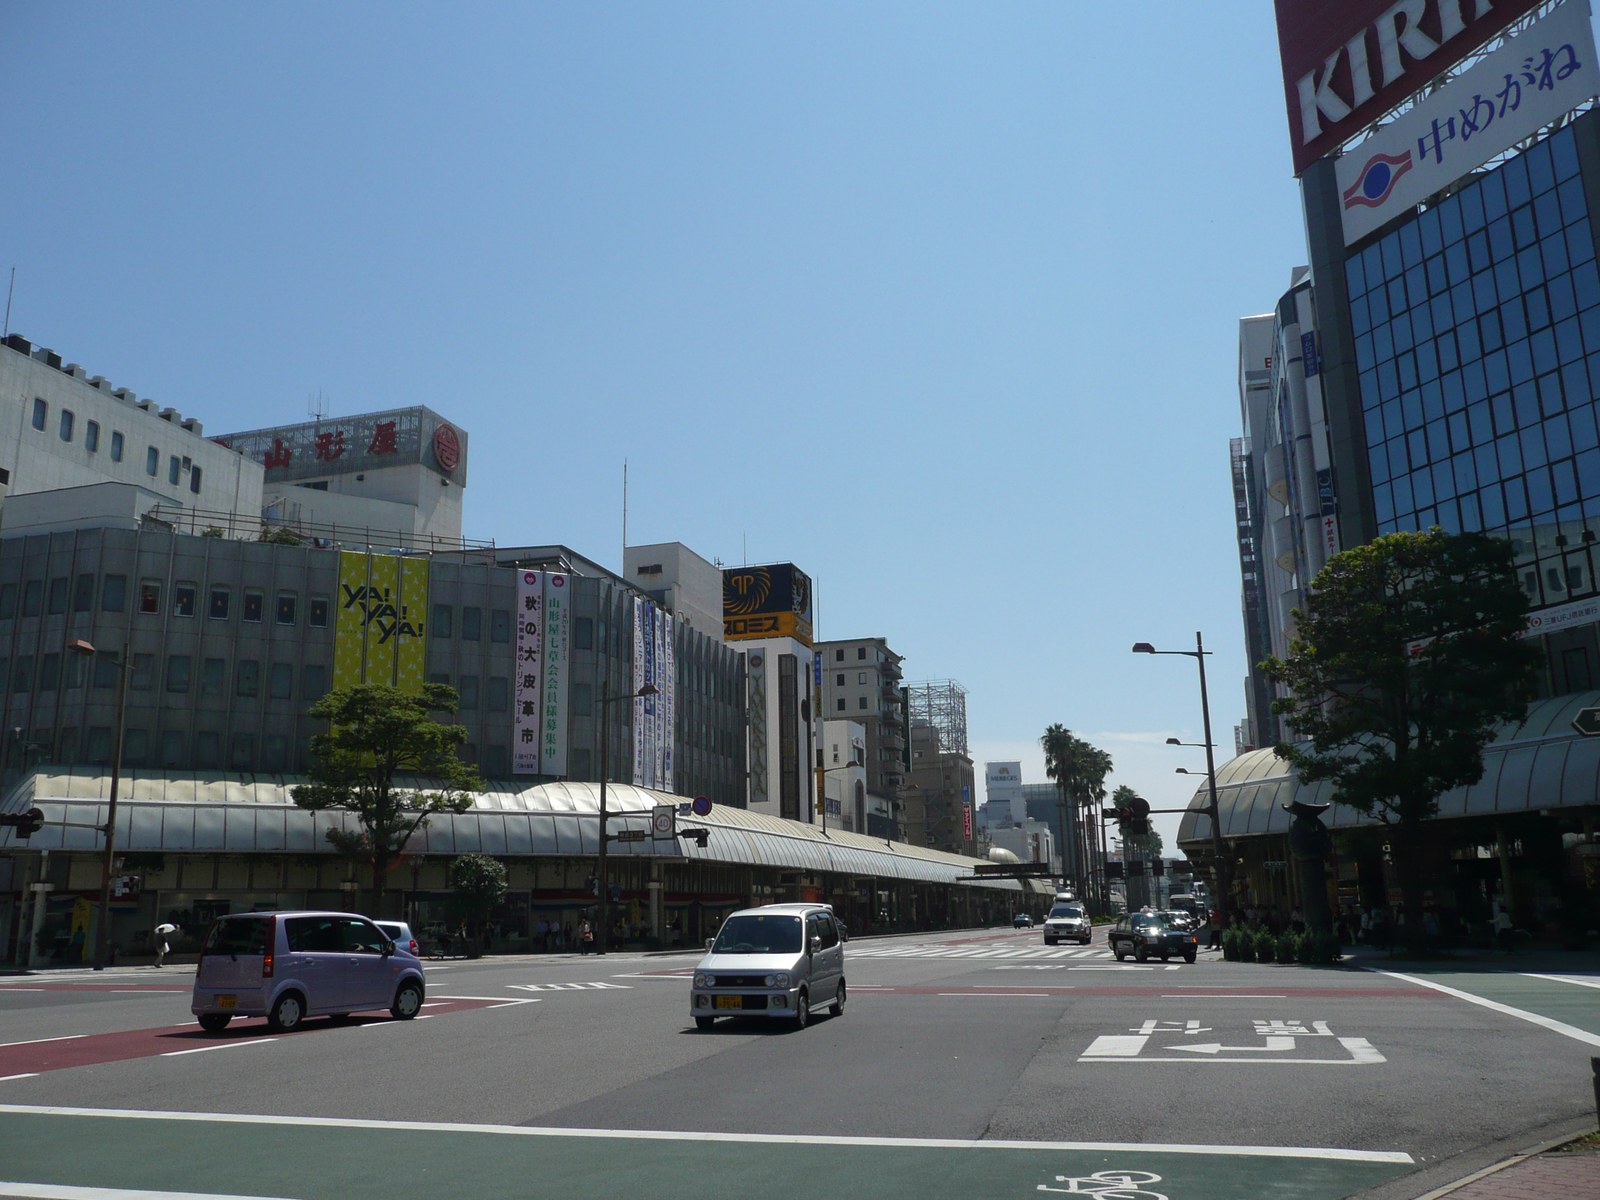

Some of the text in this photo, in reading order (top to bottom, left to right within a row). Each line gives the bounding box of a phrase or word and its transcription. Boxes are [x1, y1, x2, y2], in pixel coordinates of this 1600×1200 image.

[1297, 0, 1494, 146] KIRI
[1418, 43, 1581, 164] 中めがね
[264, 421, 398, 470] 山形屋
[1319, 474, 1333, 508] TBC
[341, 583, 390, 609] YA!
[358, 601, 408, 626] YA!
[375, 618, 424, 645] YA!
[521, 596, 537, 744] 秋の大皮革市
[545, 597, 560, 760] 山形屋七草会会員様募集中
[659, 818, 668, 828] 40
